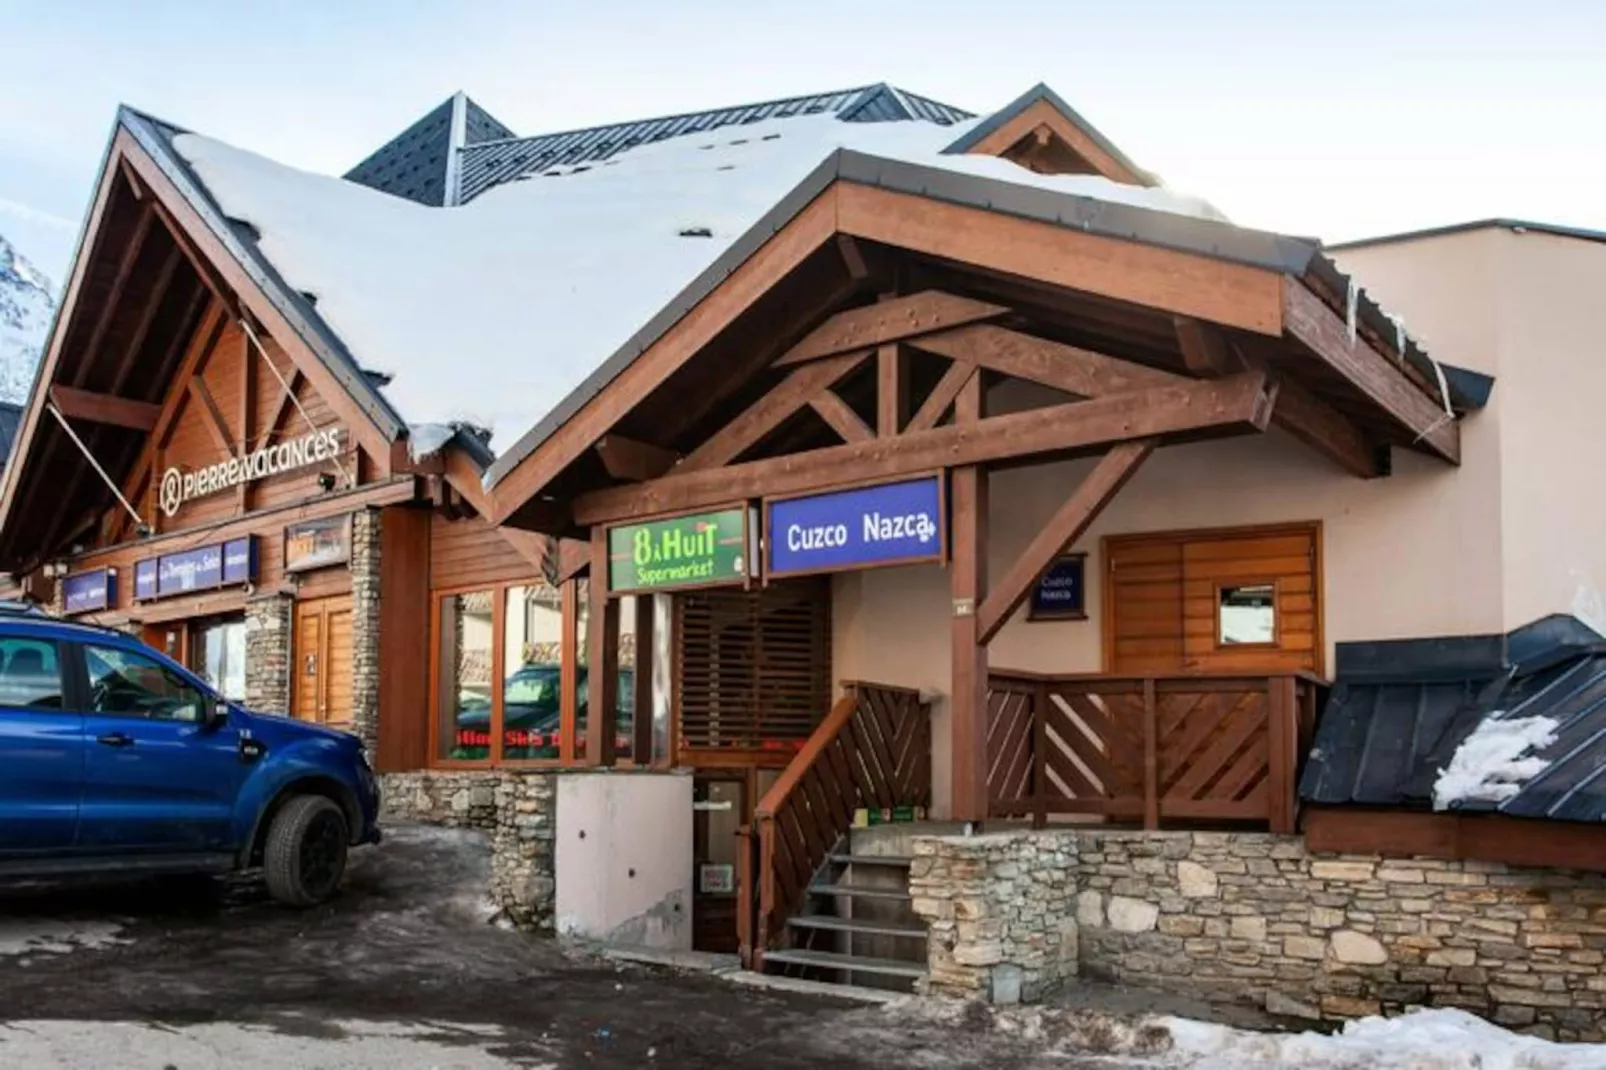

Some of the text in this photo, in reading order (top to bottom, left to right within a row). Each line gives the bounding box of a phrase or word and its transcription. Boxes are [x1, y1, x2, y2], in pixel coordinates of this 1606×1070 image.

[787, 512, 929, 551] Cuzco Nazca
[637, 559, 714, 586] Supermarket
